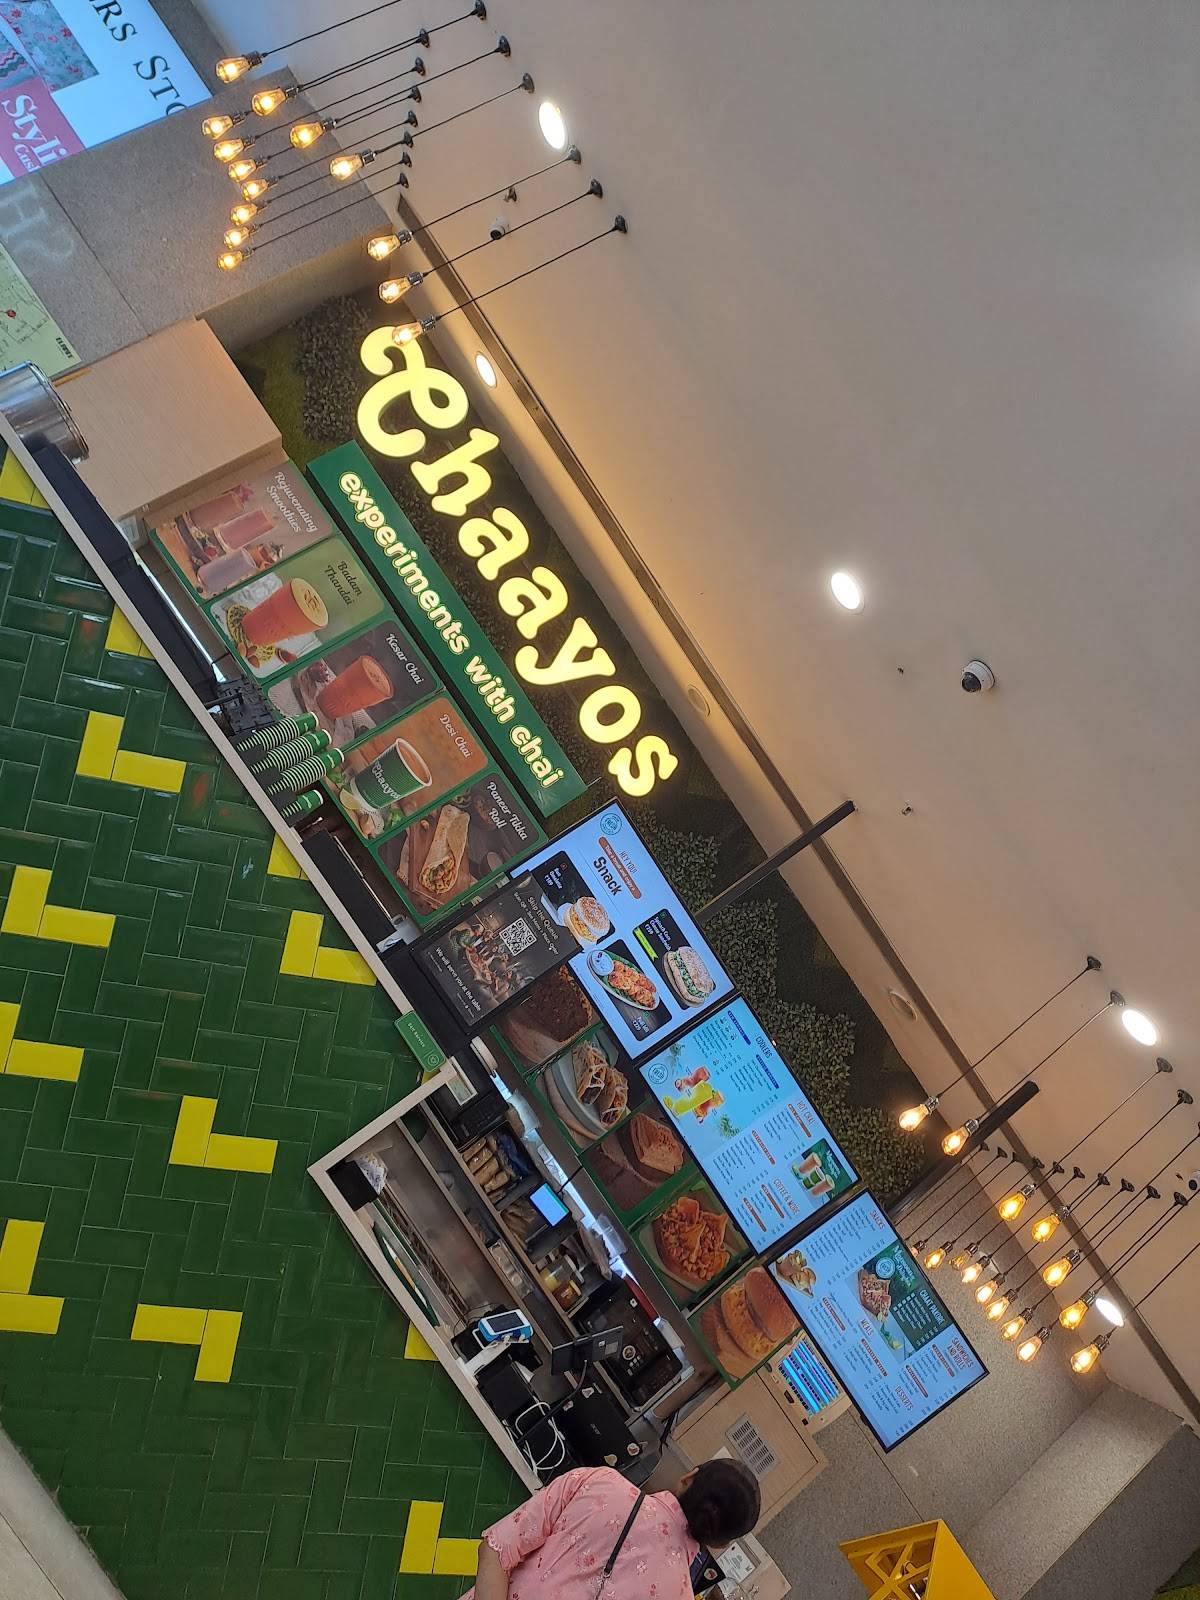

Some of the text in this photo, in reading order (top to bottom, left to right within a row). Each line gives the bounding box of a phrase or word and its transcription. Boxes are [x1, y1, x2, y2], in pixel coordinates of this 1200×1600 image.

[88, 0, 138, 42] RS
[267, 486, 301, 532] Smoothies
[275, 472, 317, 532] Rejuvenating
[338, 561, 362, 596] Badam
[357, 323, 678, 796] Chaayos
[325, 565, 354, 605] Thandai
[340, 474, 563, 788] experiments with chai
[386, 634, 424, 684] Kesar Chai
[440, 714, 472, 758] Desi Chai
[372, 761, 401, 800] Chaayos
[487, 782, 527, 840] Paneer Tikka
[489, 808, 507, 828] Roll
[592, 855, 622, 896] Snack
[618, 850, 629, 861] HEY
[526, 896, 540, 911] Skip
[536, 909, 546, 921] the
[542, 918, 559, 940] Queue
[653, 916, 666, 932] Spinach
[548, 942, 559, 954] Order
[435, 947, 443, 956] We
[441, 955, 450, 965] will
[446, 964, 457, 977] serve
[454, 976, 463, 986] you
[465, 990, 473, 999] the
[470, 998, 481, 1011] table
[754, 1035, 773, 1058] COOLERS
[919, 1288, 933, 1306] CHAAT
[859, 1318, 874, 1335] MEALS
